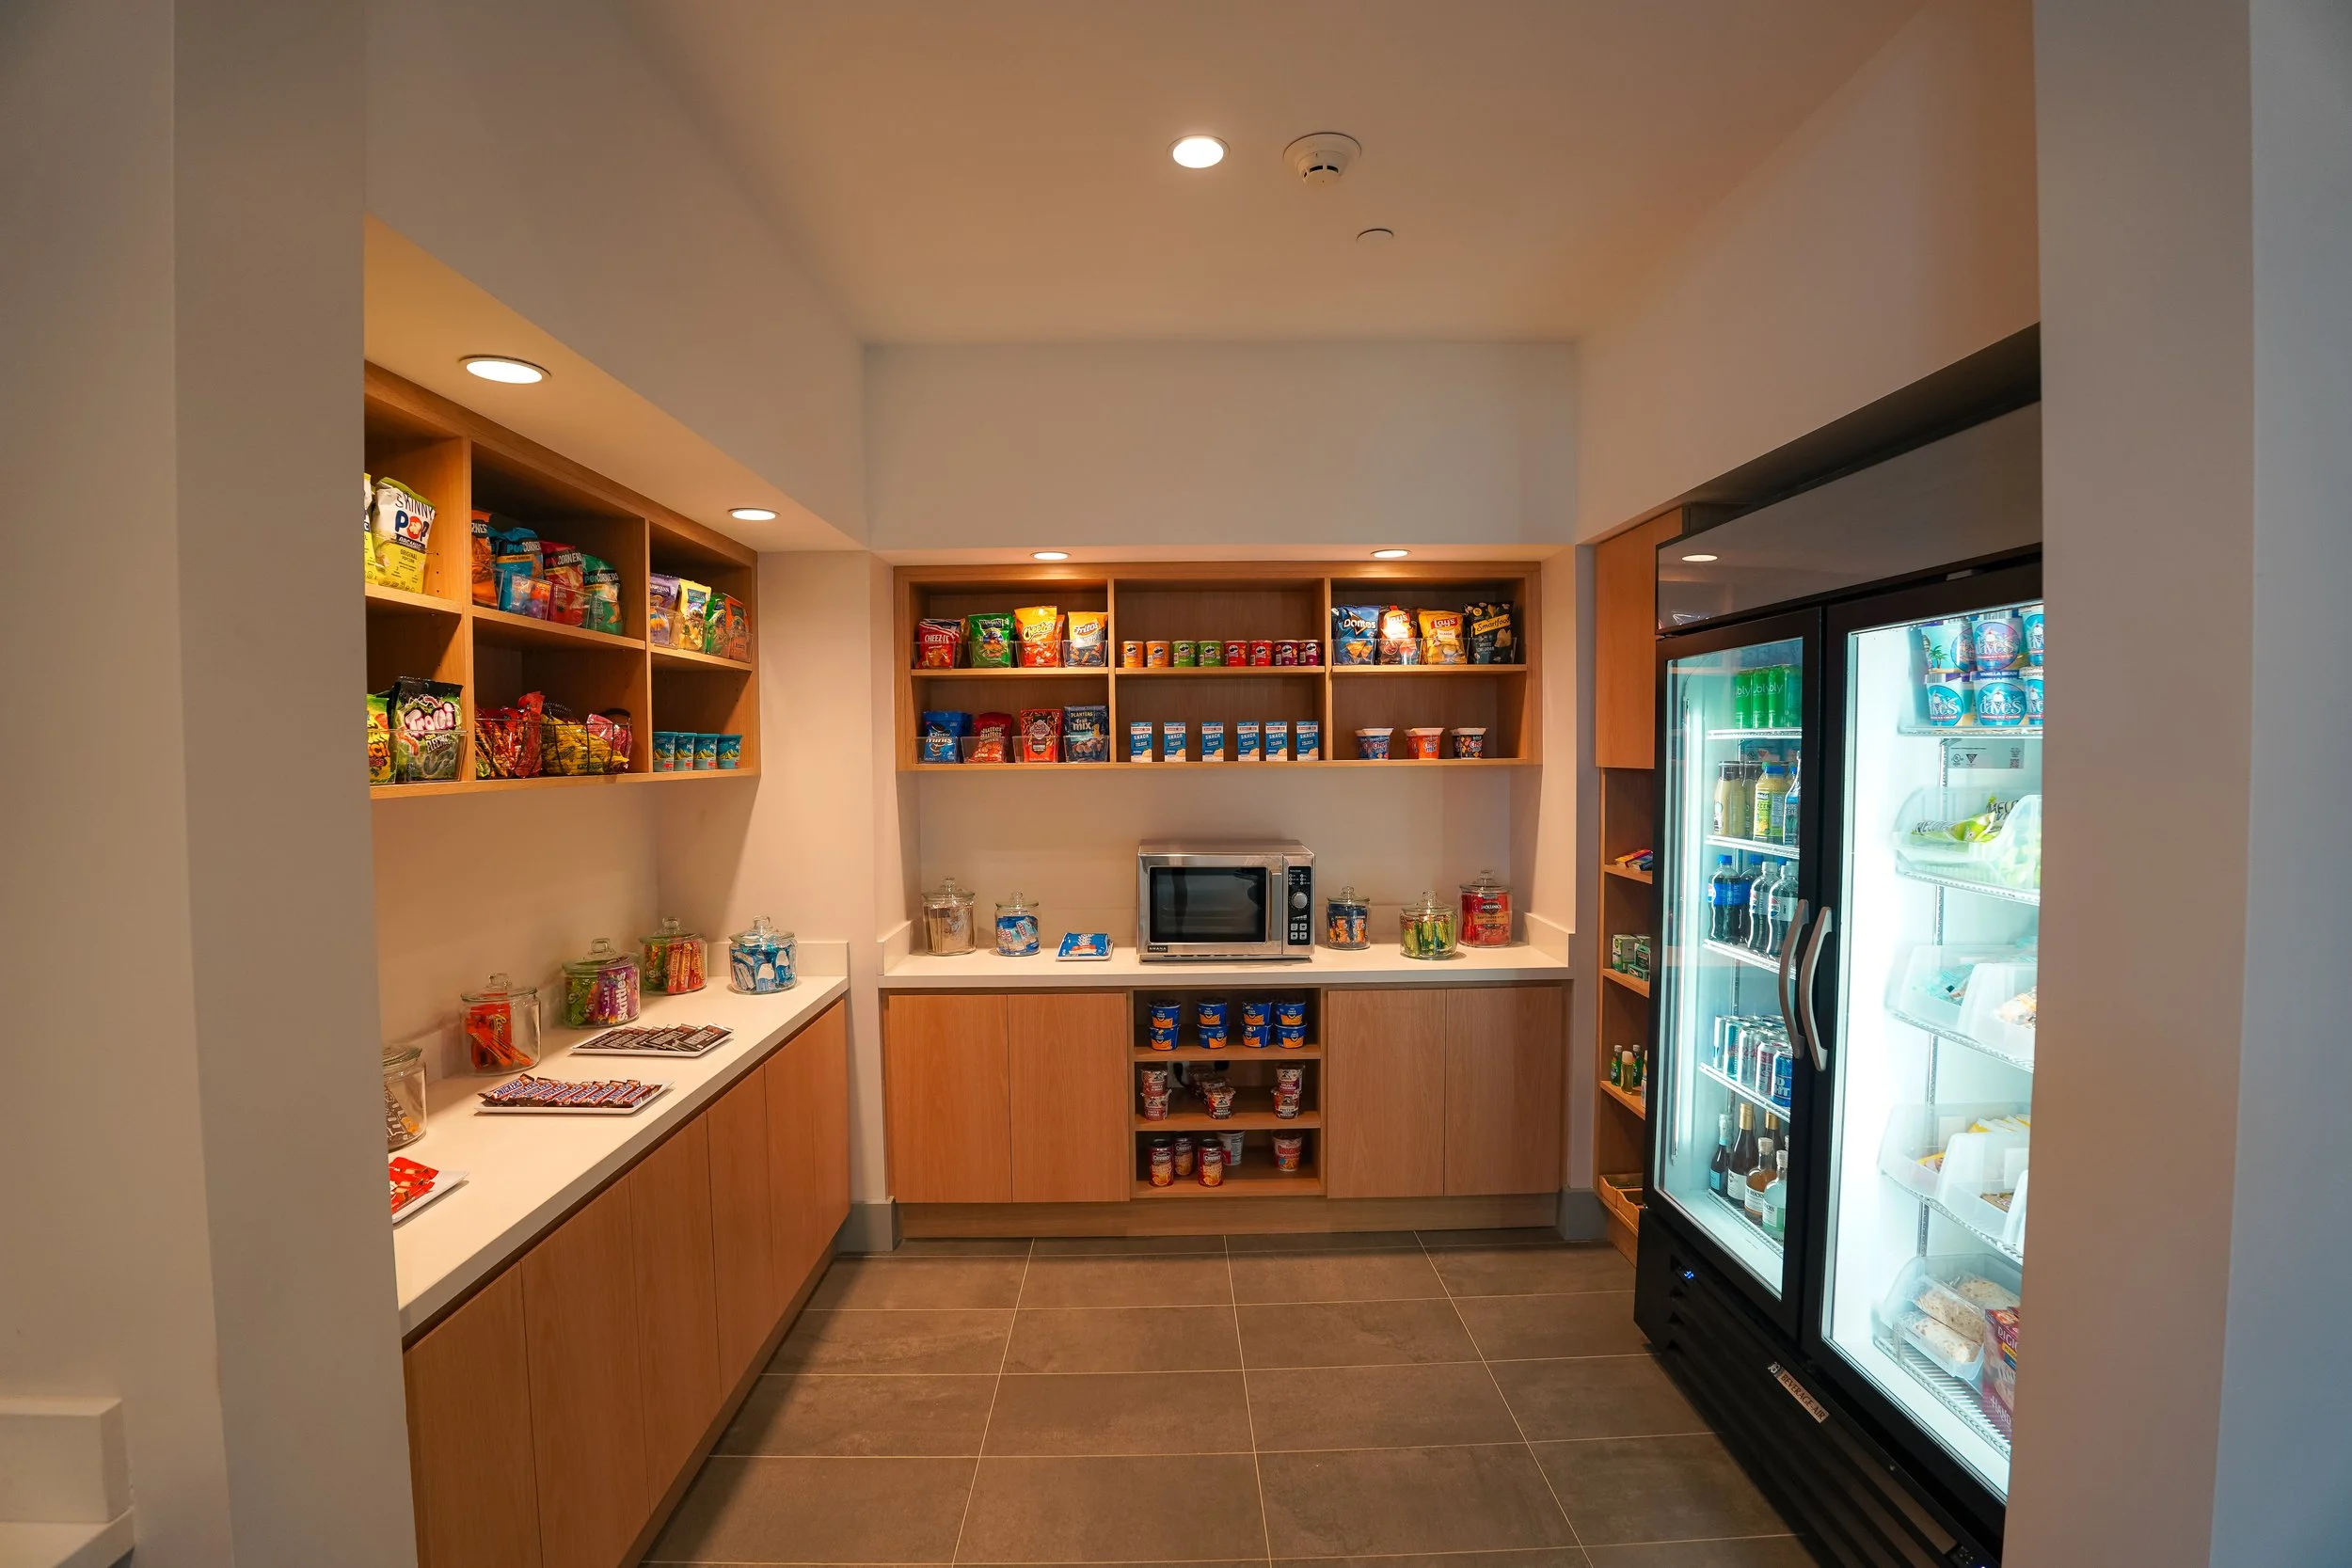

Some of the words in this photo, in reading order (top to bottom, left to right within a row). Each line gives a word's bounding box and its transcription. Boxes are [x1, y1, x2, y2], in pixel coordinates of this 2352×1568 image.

[395, 491, 436, 522] SKINNY
[395, 510, 430, 542] POP
[1023, 622, 1055, 641] Cheetos
[1073, 622, 1099, 635] Fritos
[1343, 619, 1376, 628] Doritos
[1434, 617, 1455, 627] Lay's
[404, 702, 456, 736] Trolli
[1072, 722, 1090, 731] mix
[615, 971, 628, 1022] Skittles
[495, 1079, 522, 1098] SNICKERS
[542, 1085, 566, 1100] SNICKERS
[1780, 1373, 1827, 1420] BEVERAGE-AIR
